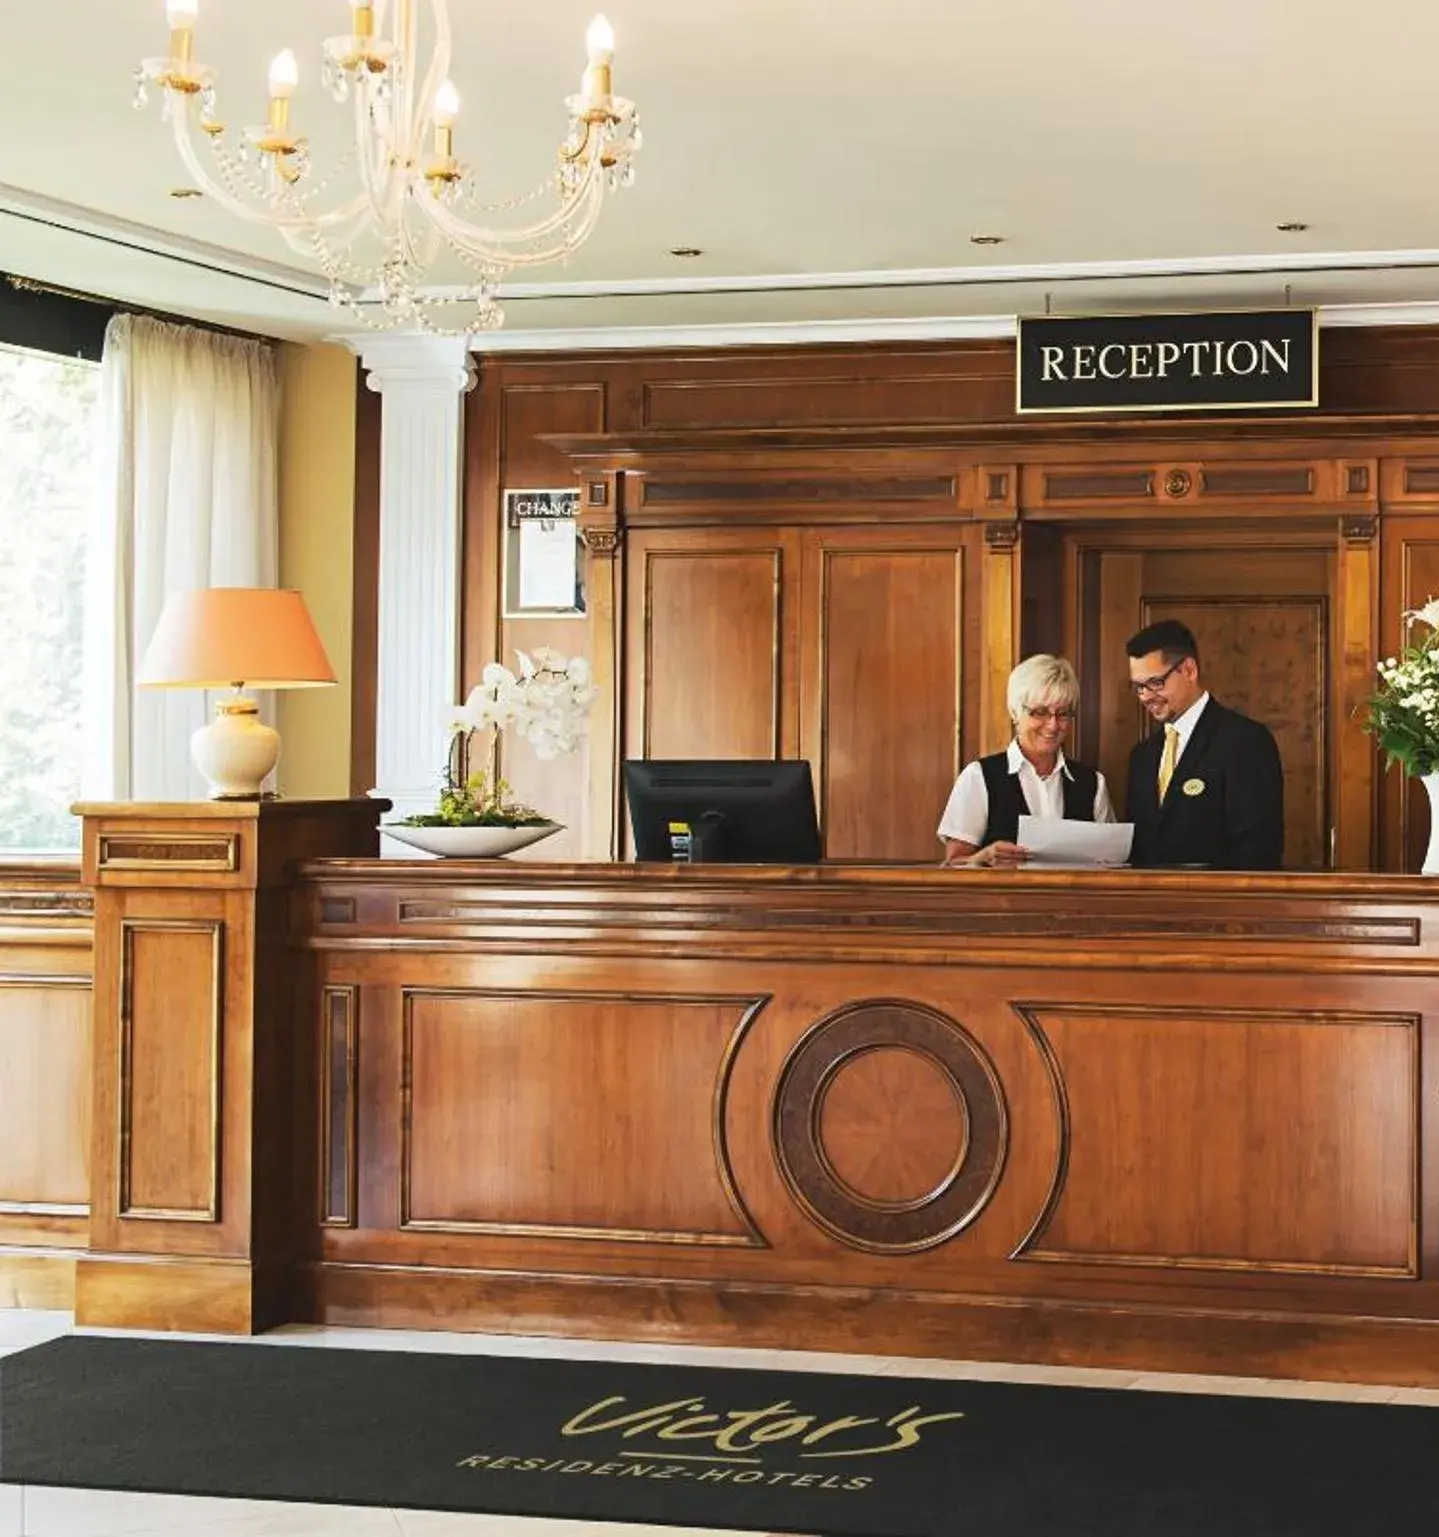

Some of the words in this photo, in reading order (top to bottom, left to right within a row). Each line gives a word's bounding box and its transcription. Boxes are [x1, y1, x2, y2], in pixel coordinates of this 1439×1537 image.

[1040, 338, 1291, 381] RECEPTION
[517, 500, 581, 516] CHANGE
[561, 1396, 965, 1458] Victor's
[456, 1454, 875, 1491] RESIDENZ-HOTELS
